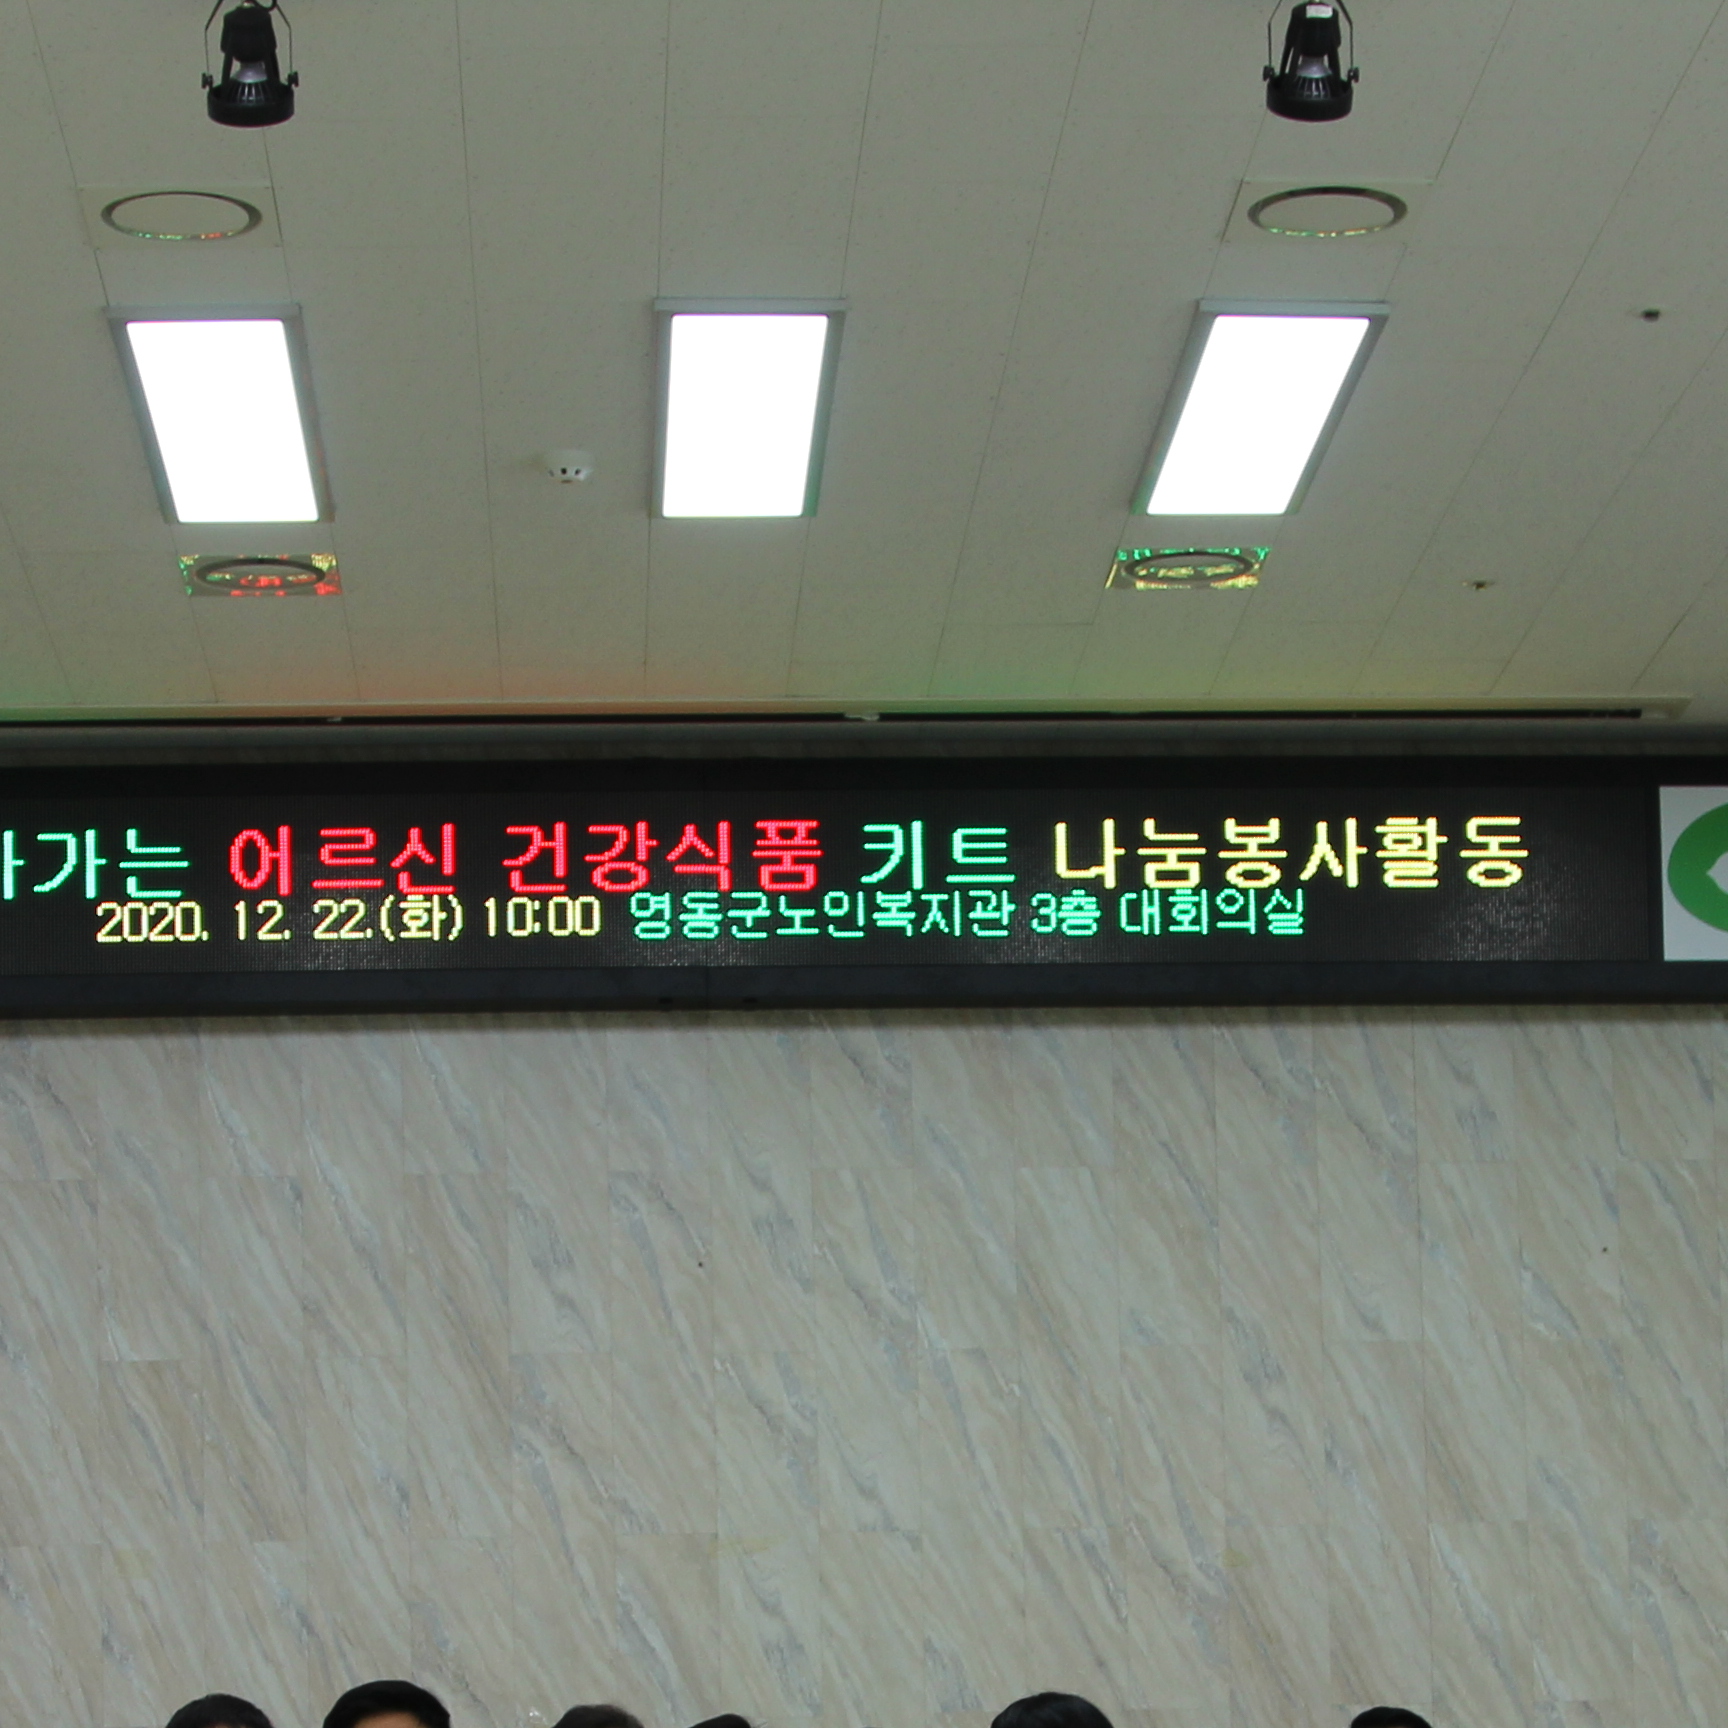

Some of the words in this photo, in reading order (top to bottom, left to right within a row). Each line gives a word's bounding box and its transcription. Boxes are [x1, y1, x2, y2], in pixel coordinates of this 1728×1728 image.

[229, 823, 455, 896] 어르신
[502, 819, 823, 893] 건강식품
[860, 820, 1015, 888] 키트
[96, 901, 208, 943] 2020.
[235, 899, 290, 941] 12.
[313, 896, 463, 942] 22.(화)
[485, 896, 601, 938] 10:00
[630, 891, 1016, 940] 영동군노인복지관
[1031, 889, 1101, 936] 3층
[1118, 888, 1304, 936] 대회의실
